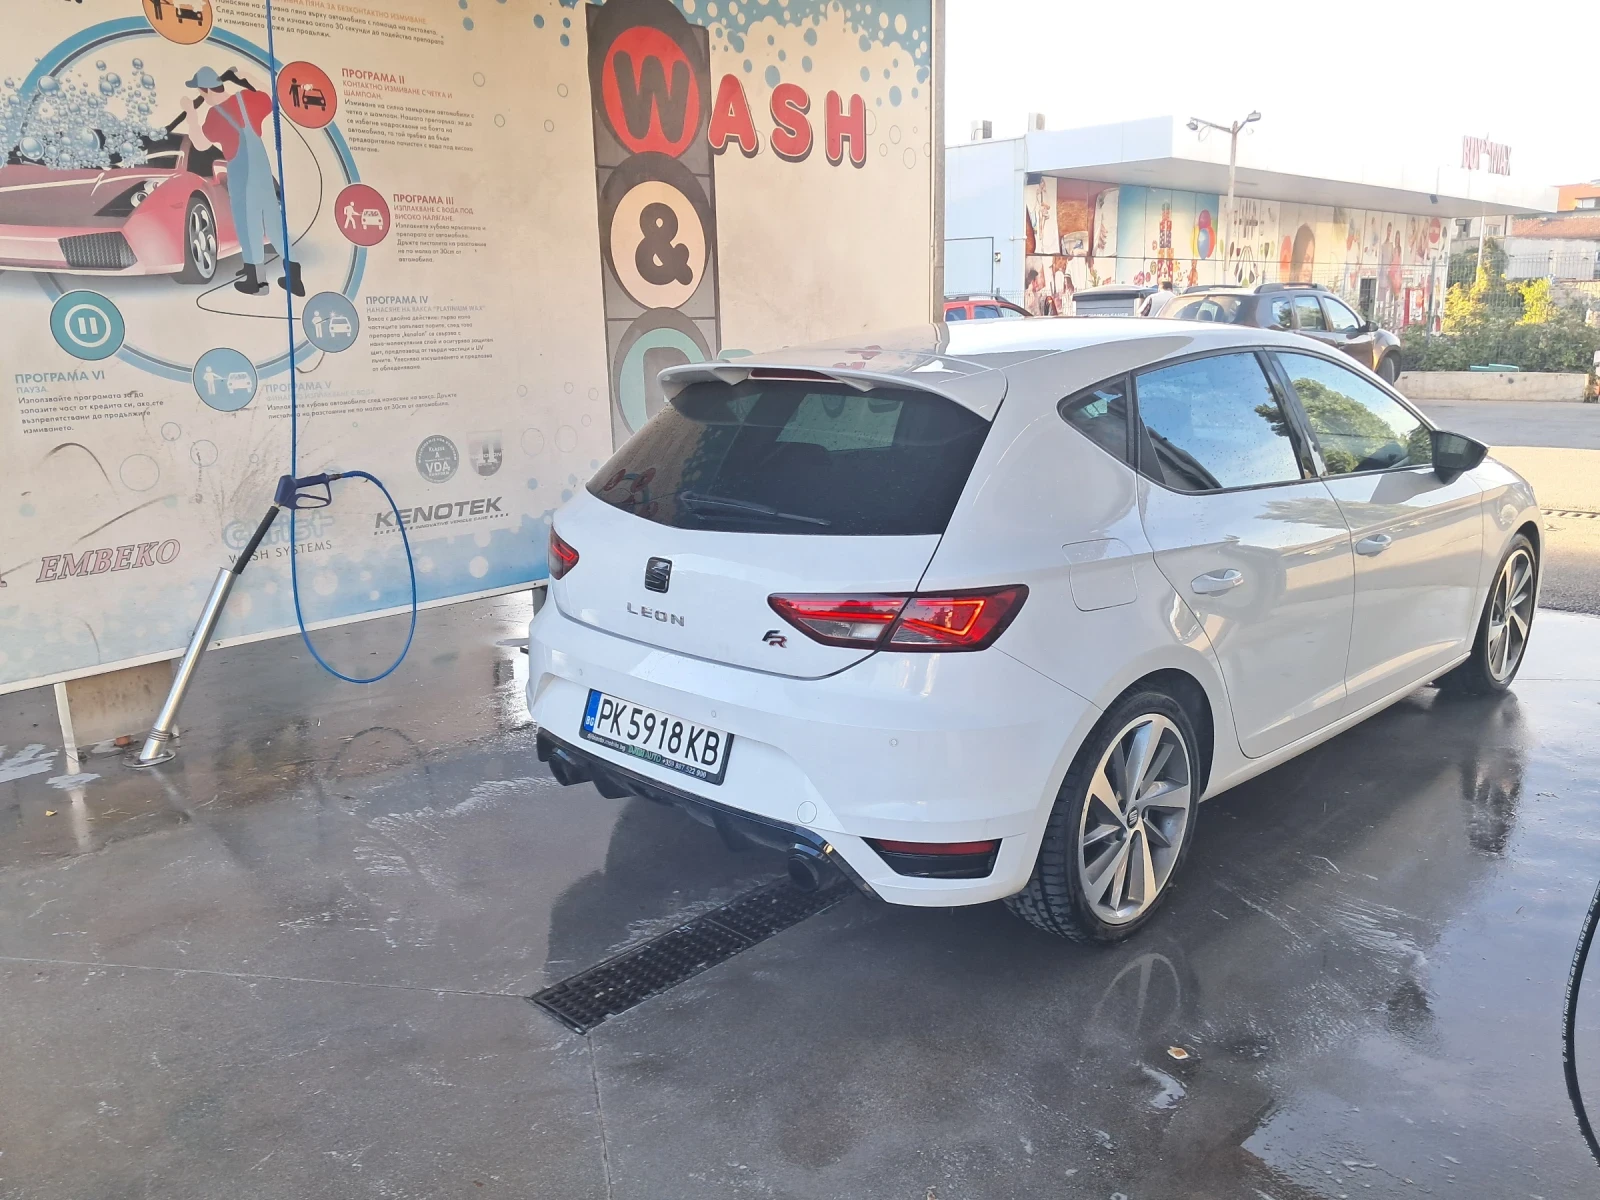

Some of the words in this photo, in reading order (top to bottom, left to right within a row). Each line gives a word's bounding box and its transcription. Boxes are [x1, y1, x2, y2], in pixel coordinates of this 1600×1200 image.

[262, 5, 289, 13] ативна
[335, 22, 344, 31] 30
[342, 68, 396, 84] ПРОГРАМА
[399, 75, 405, 85] II
[613, 51, 866, 169] WASH
[393, 194, 444, 205] ПРОГРАМА
[394, 213, 421, 221] ВИСОКО
[635, 202, 693, 286] &
[366, 295, 417, 305] ПРОГРАМА
[419, 295, 429, 304] IV
[15, 371, 89, 384] ПРОГРАМА
[92, 370, 105, 380] VI
[18, 395, 72, 404] Използвайте
[74, 394, 121, 402] програмата
[20, 406, 57, 415] запазите
[90, 403, 122, 411] кредита
[22, 415, 90, 425] възпрепятствани
[426, 461, 450, 473] VDA
[375, 496, 502, 528] KENOTEK
[35, 539, 181, 583] EMBEKO
[229, 549, 269, 564] WSH
[626, 602, 685, 627] LEON
[762, 630, 788, 649] FR
[585, 715, 595, 727] BG
